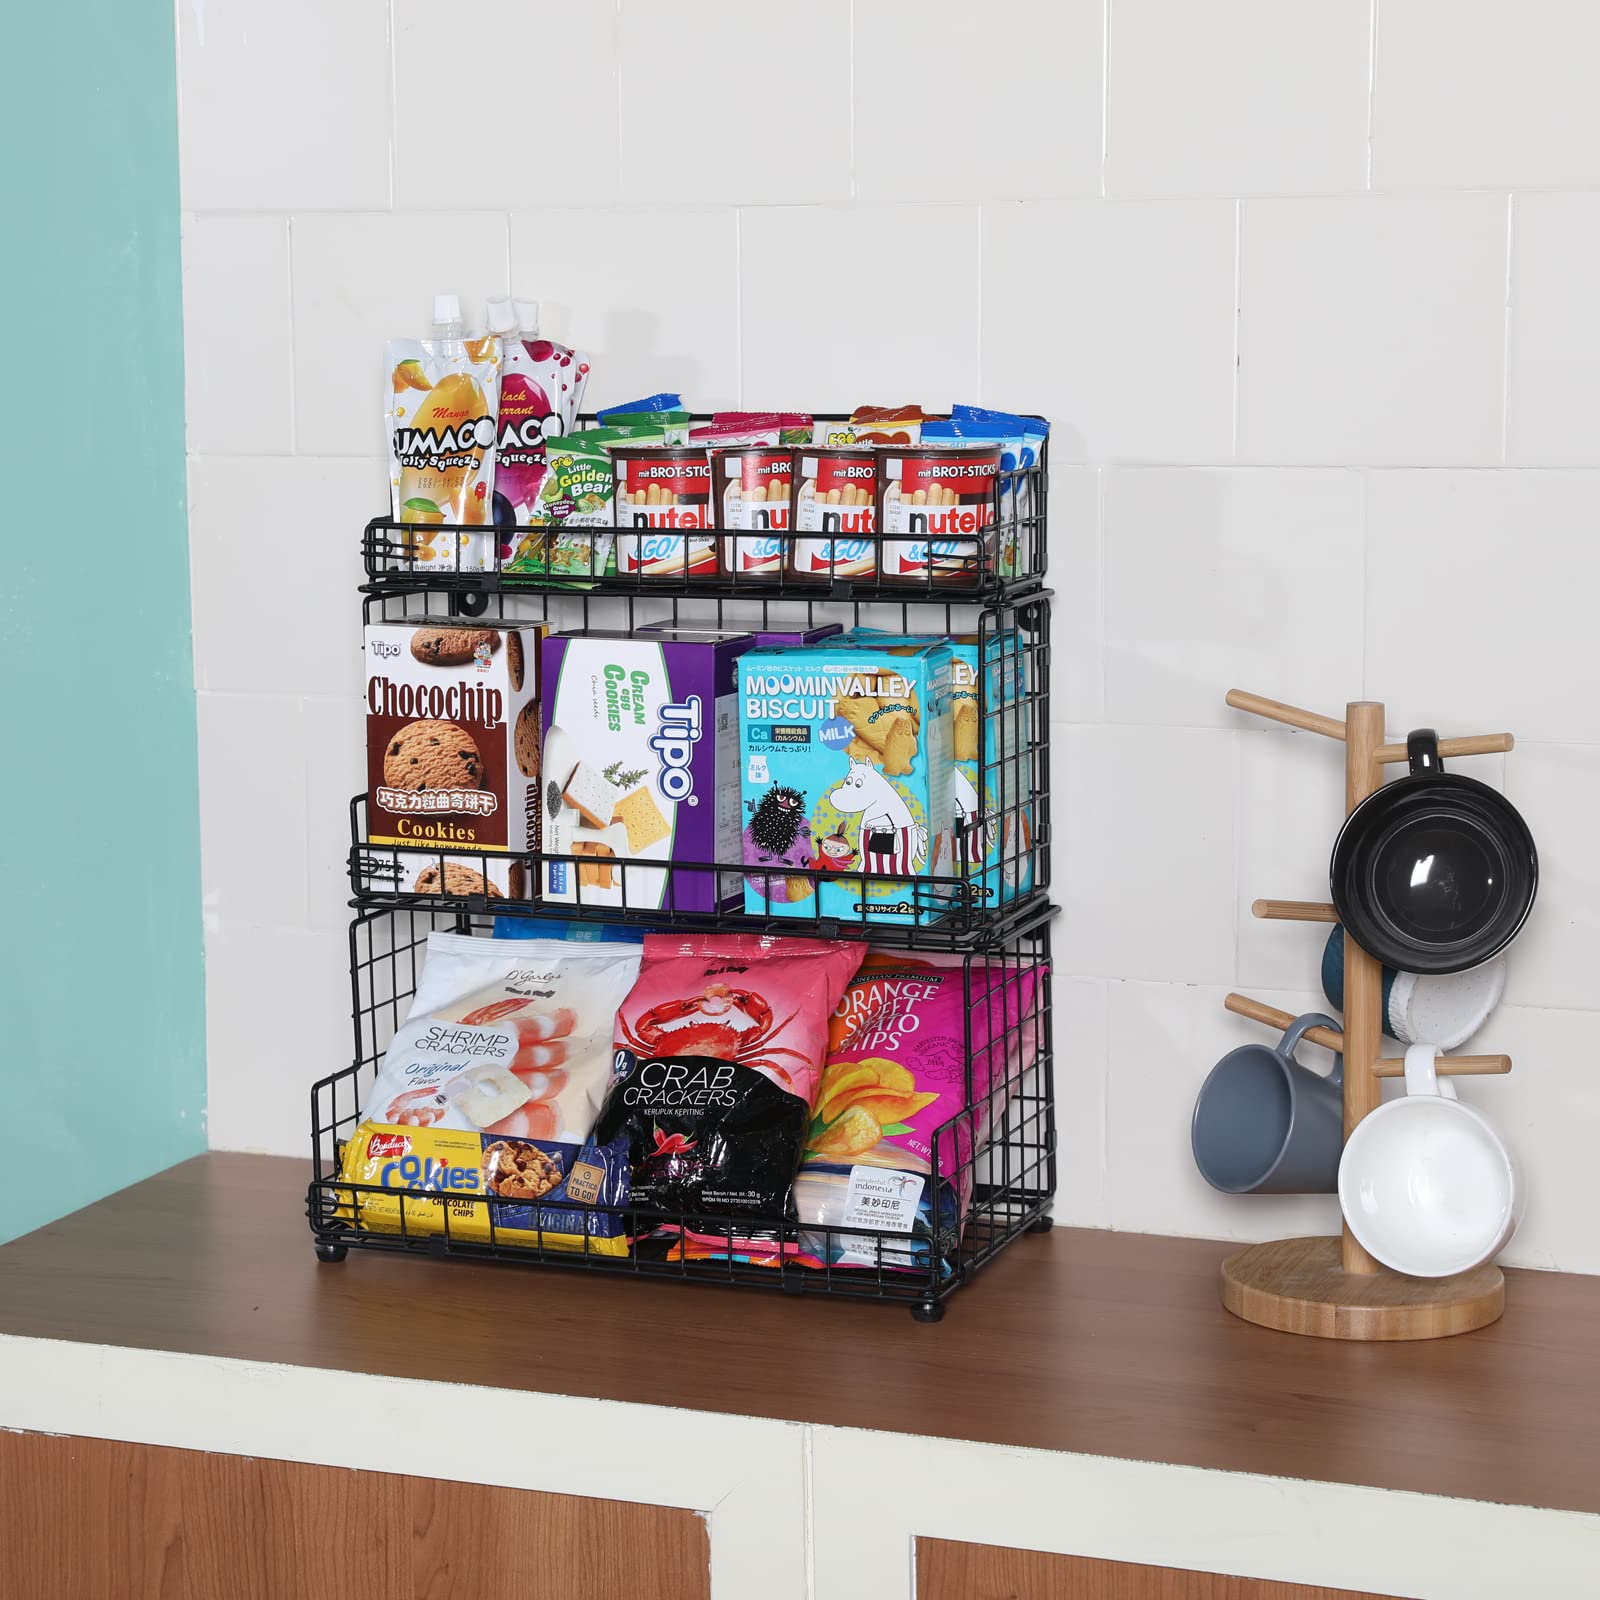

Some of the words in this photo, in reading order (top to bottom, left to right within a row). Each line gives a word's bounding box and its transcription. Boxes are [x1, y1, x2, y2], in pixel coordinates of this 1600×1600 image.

[501, 390, 526, 401] lack
[432, 407, 469, 419] Mango
[498, 405, 534, 415] urrant
[499, 414, 563, 450] ACO
[429, 455, 479, 471] Squeeze
[568, 464, 591, 473] Little
[932, 464, 995, 478] BROT-STICKS
[560, 469, 612, 488] Golden
[571, 483, 612, 497] Bear
[751, 508, 789, 530] nu
[822, 508, 876, 533] nut
[820, 538, 870, 561] &GO!
[372, 641, 400, 657] Tipo
[953, 664, 978, 686] EY
[746, 674, 917, 699] MOOMINVALLEY
[368, 676, 502, 729] Chocochip
[620, 688, 631, 711] egg
[746, 699, 839, 720] BISCUIT
[751, 728, 768, 740] Ca
[819, 724, 856, 742] MILK
[649, 696, 701, 800] Tipo
[748, 745, 811, 753] カルシウムたっぷり!
[378, 789, 496, 814] 巧克力粒曲奇饼干
[397, 819, 475, 841] Cookies
[834, 982, 939, 1017] ORANGE
[426, 1026, 509, 1047] SHRIMP
[415, 1039, 508, 1058] CRACKERS
[405, 1060, 471, 1077] Original
[640, 1063, 735, 1089] CRAB
[408, 1077, 441, 1086] Flavor
[623, 1087, 738, 1106] CRACKERS
[644, 1108, 673, 1116] KERUPUK
[675, 1108, 705, 1116] KEPITING
[907, 1138, 921, 1151] NET.
[572, 1178, 598, 1191] PRACTICO
[855, 1182, 893, 1193] indonesia
[856, 1177, 886, 1185] wonderful
[570, 1186, 580, 1197] TO
[582, 1190, 595, 1200] GO!
[748, 1190, 756, 1198] 30
[432, 1198, 474, 1209] CHCOLATE
[861, 1196, 901, 1210] 美妙印尼
[453, 1208, 474, 1217] CHIPS
